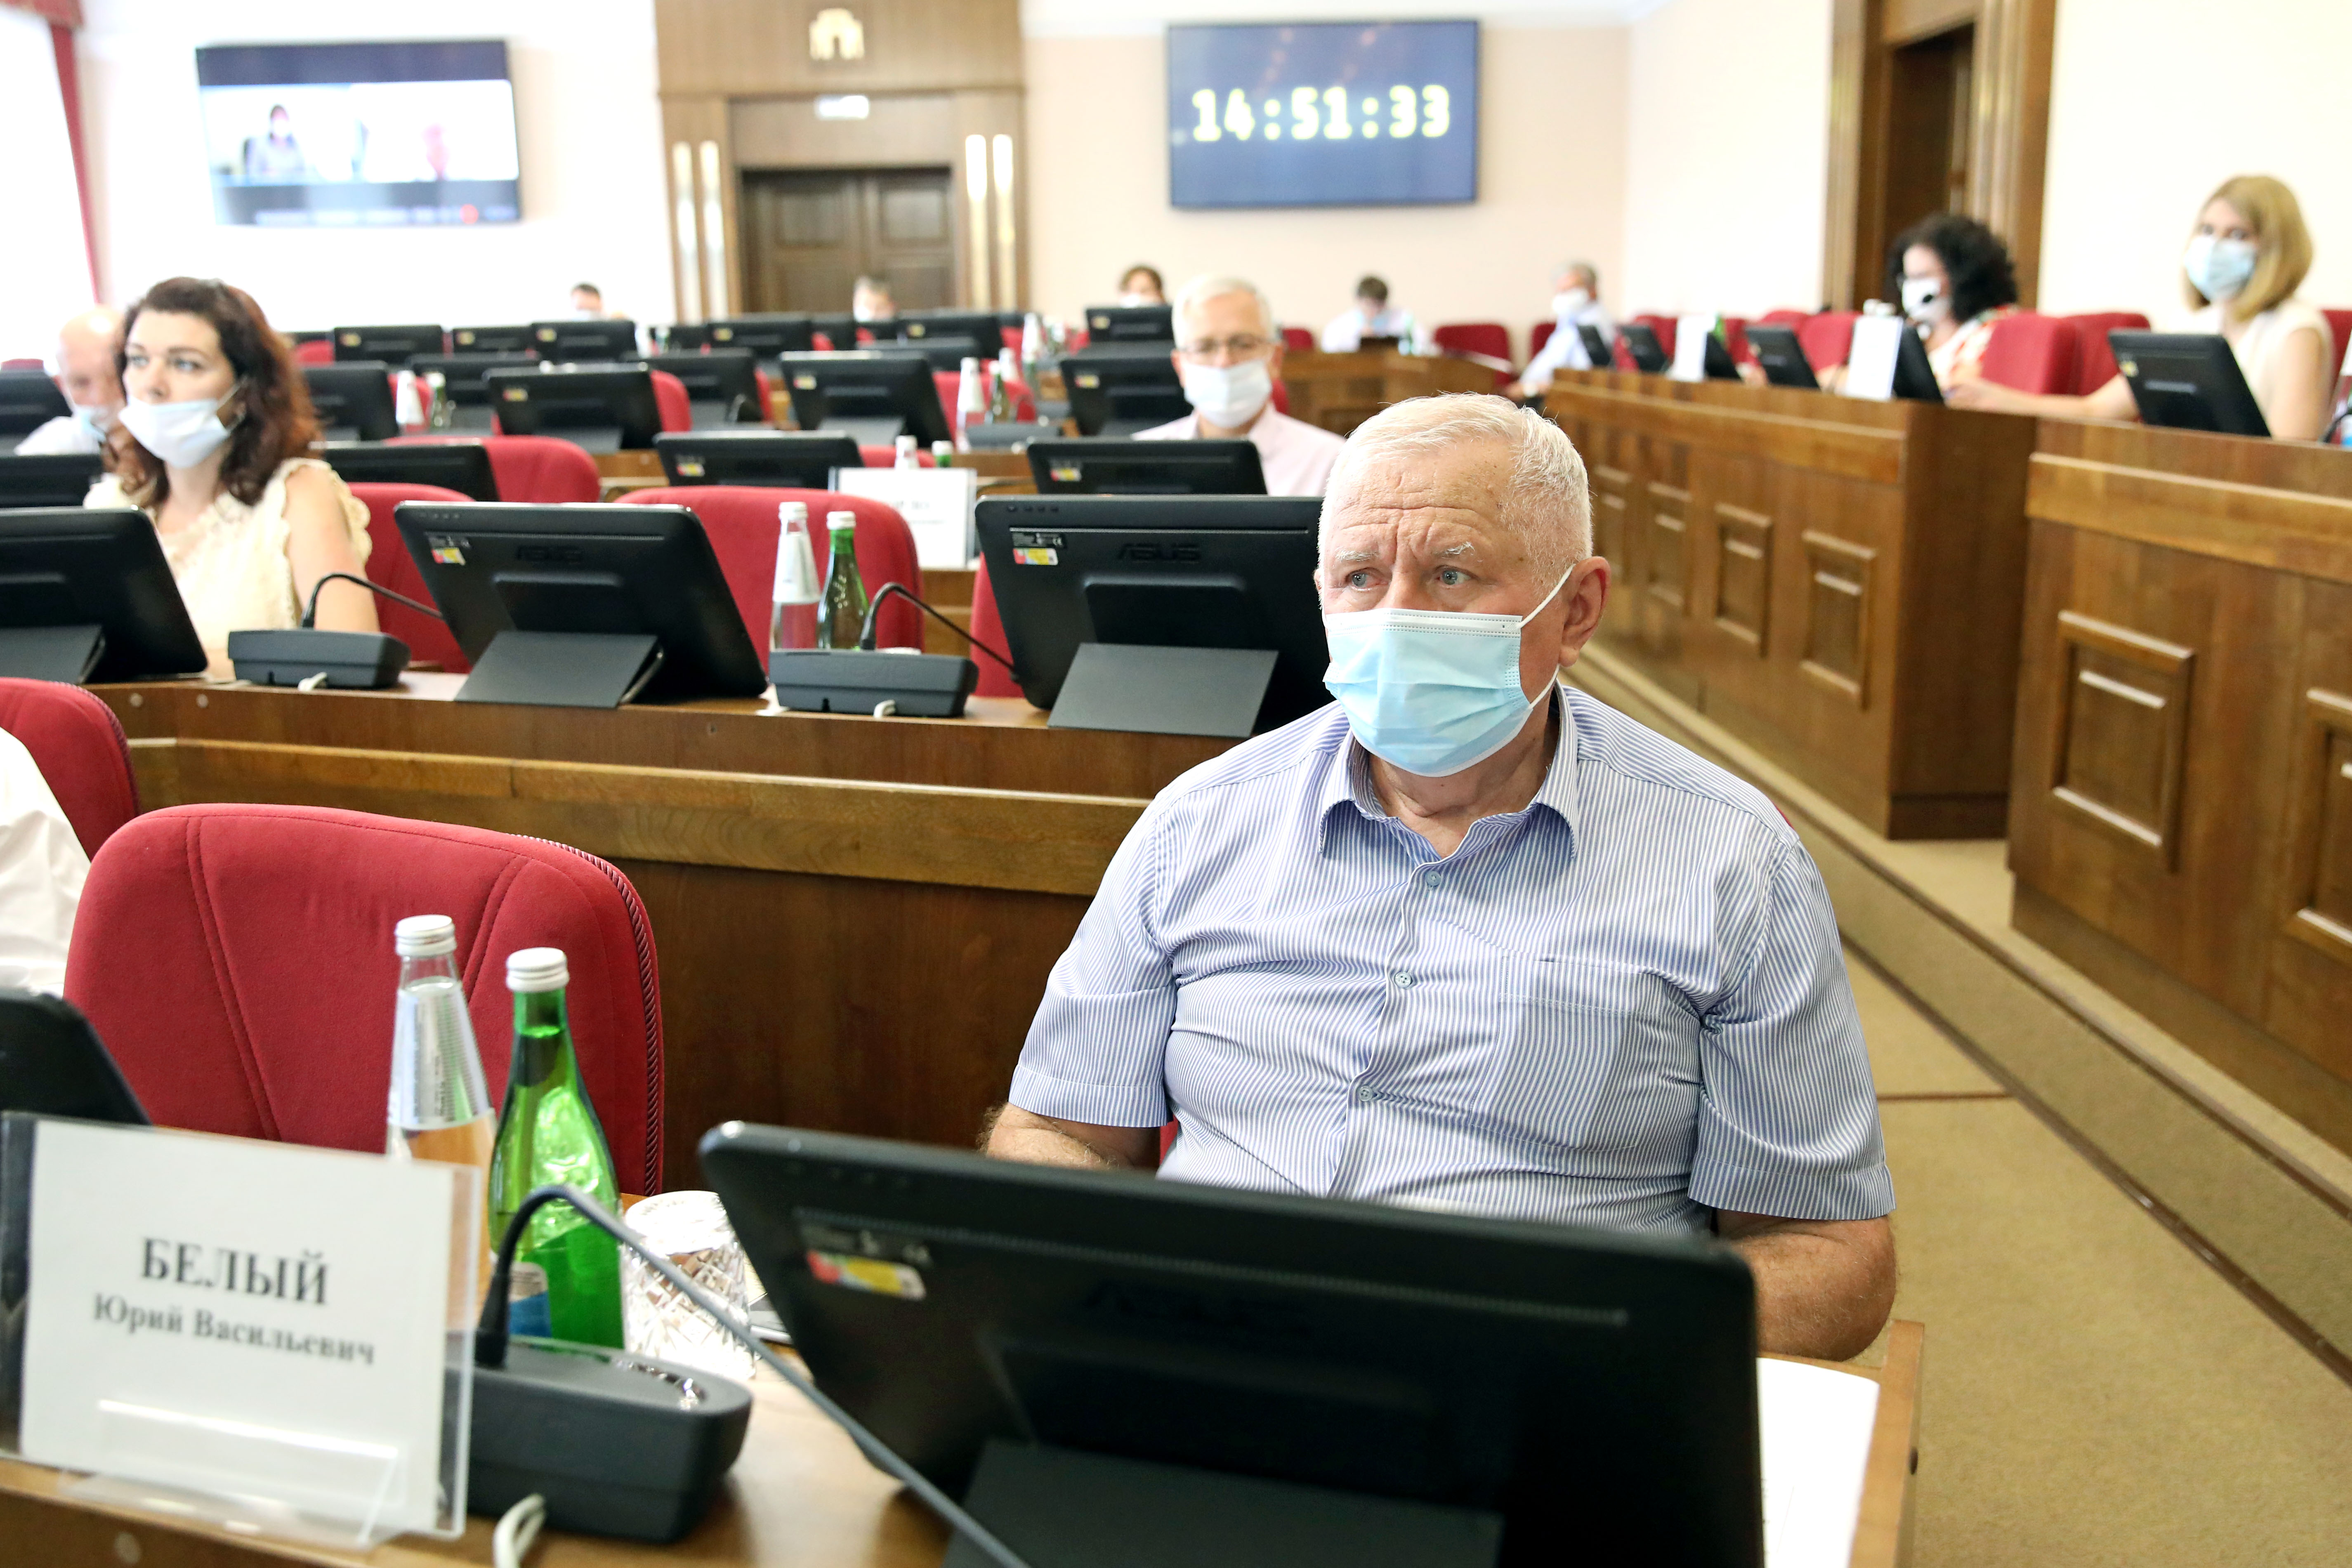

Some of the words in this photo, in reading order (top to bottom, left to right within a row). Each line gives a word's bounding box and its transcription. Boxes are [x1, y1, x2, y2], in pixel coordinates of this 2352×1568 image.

[1192, 85, 1450, 141] 14:51:33
[1117, 543, 1201, 562] ASUS
[141, 1237, 330, 1307] БЕЛЫЙ
[93, 1291, 184, 1334] Юрий
[193, 1309, 375, 1366] Васильевич
